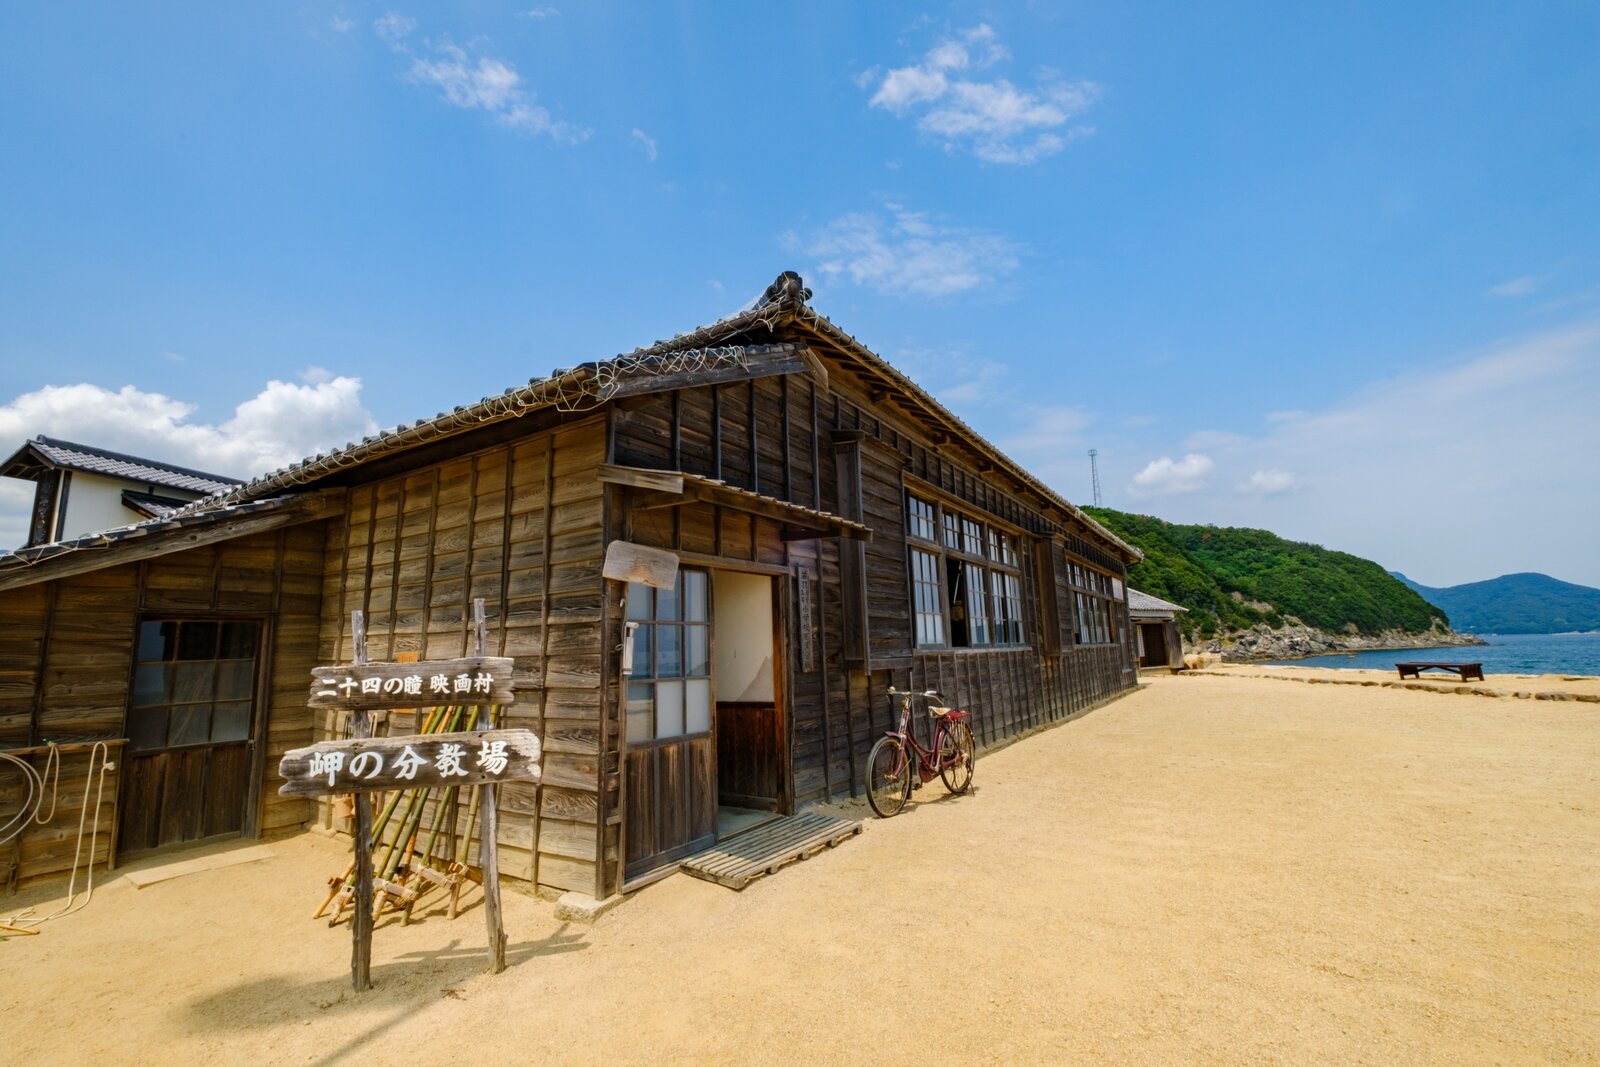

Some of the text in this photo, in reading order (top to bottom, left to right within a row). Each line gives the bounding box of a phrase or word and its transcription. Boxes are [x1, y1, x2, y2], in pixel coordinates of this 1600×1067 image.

[317, 672, 494, 697] 二十四の瞳 映画村
[309, 741, 509, 787] 岬の分教場
